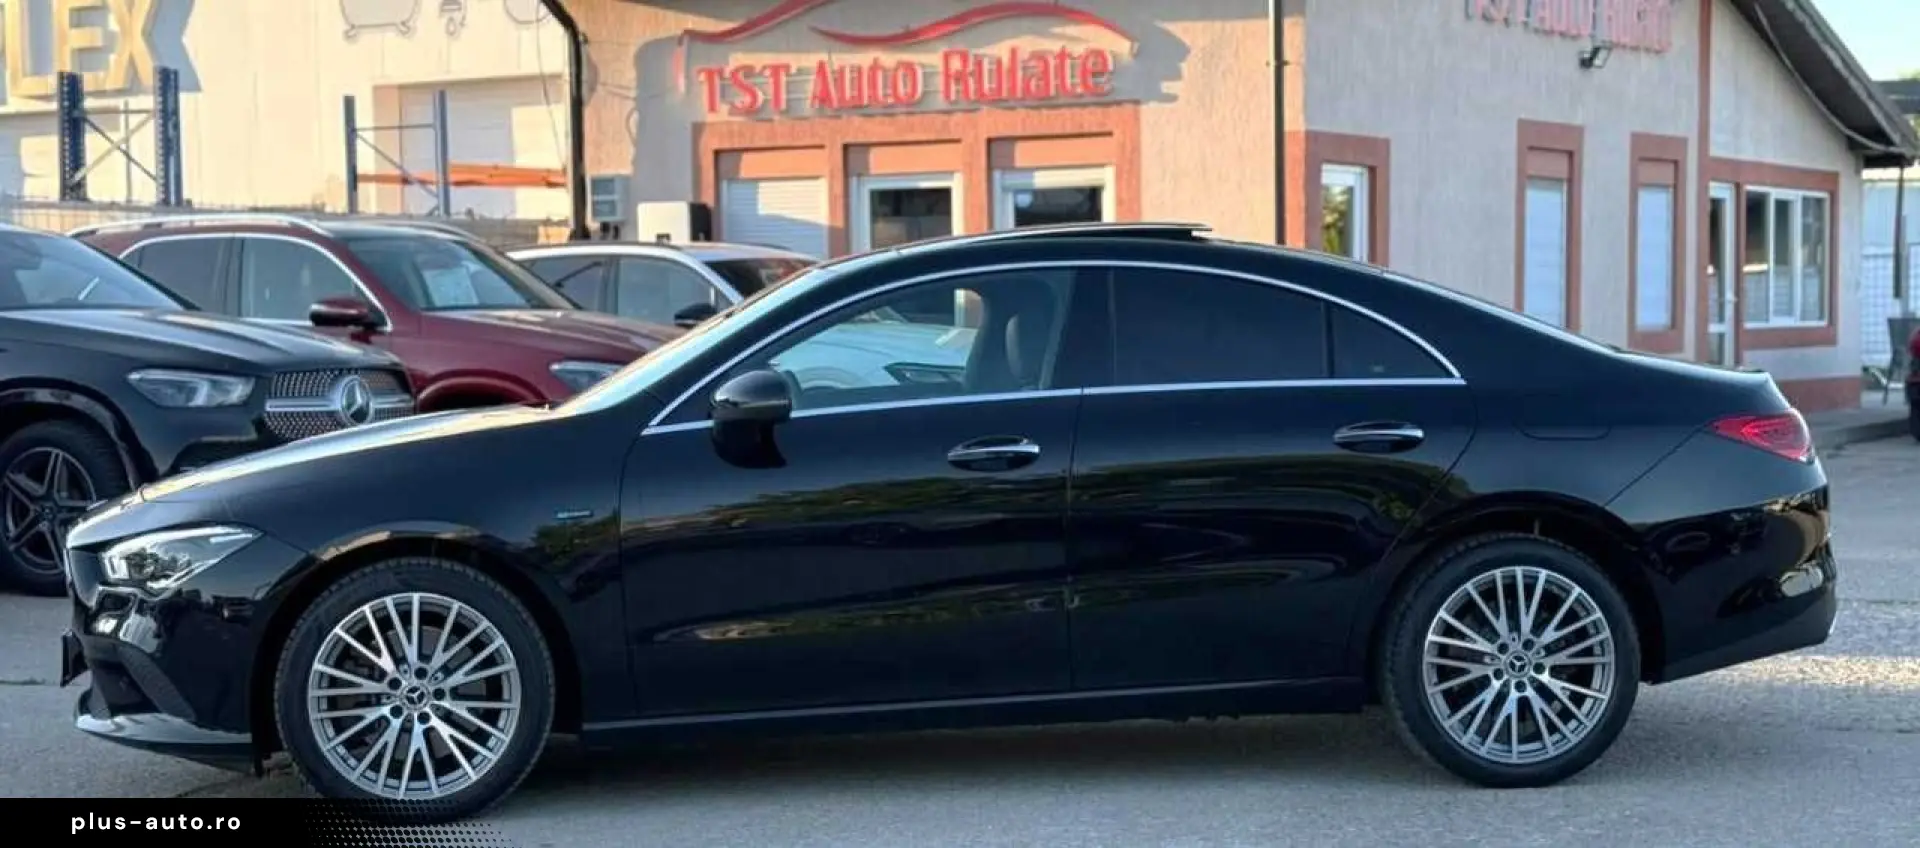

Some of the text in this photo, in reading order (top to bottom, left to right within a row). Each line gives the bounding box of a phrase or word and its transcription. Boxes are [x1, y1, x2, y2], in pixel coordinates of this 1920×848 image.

[0, 0, 157, 95] LEX
[697, 45, 1114, 114] TST Auto Rulate
